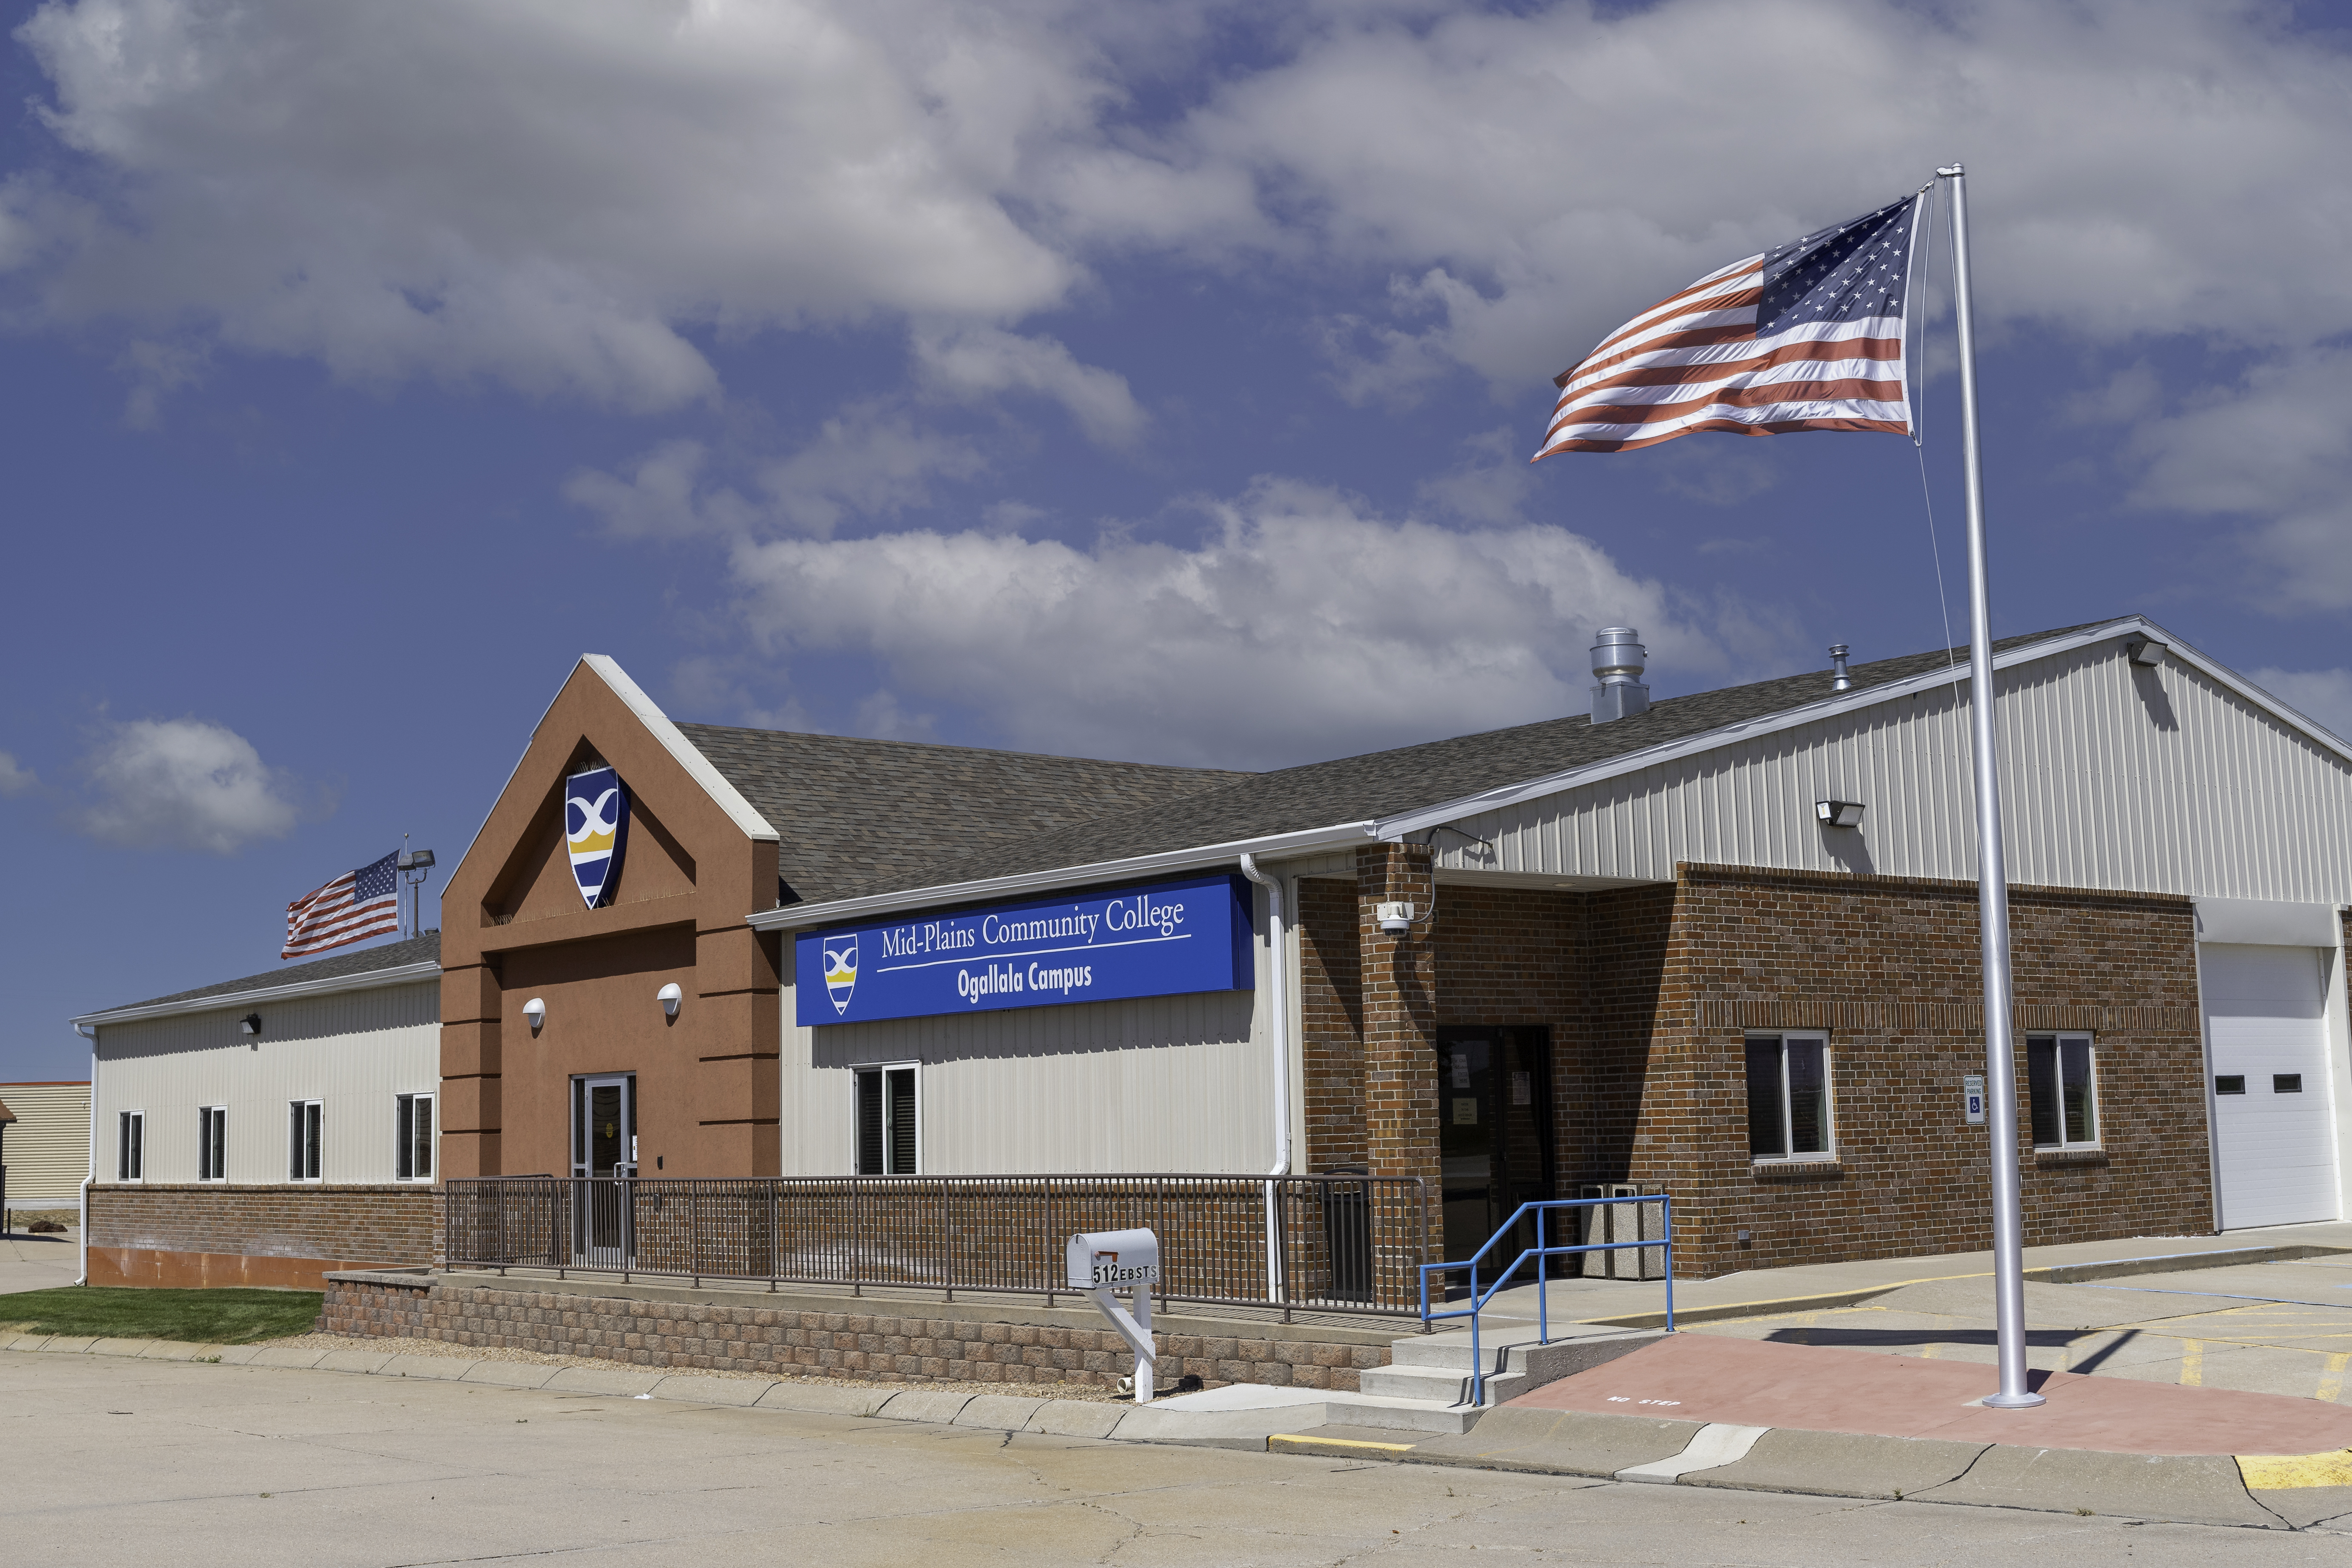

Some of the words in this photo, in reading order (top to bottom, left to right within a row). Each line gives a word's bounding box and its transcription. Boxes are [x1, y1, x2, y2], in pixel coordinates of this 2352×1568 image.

[882, 921, 974, 958] Mid-Plains
[983, 905, 1100, 944] Community
[1106, 894, 1184, 936] College
[958, 963, 1023, 1004] Ogallala
[1028, 962, 1092, 995] Campus
